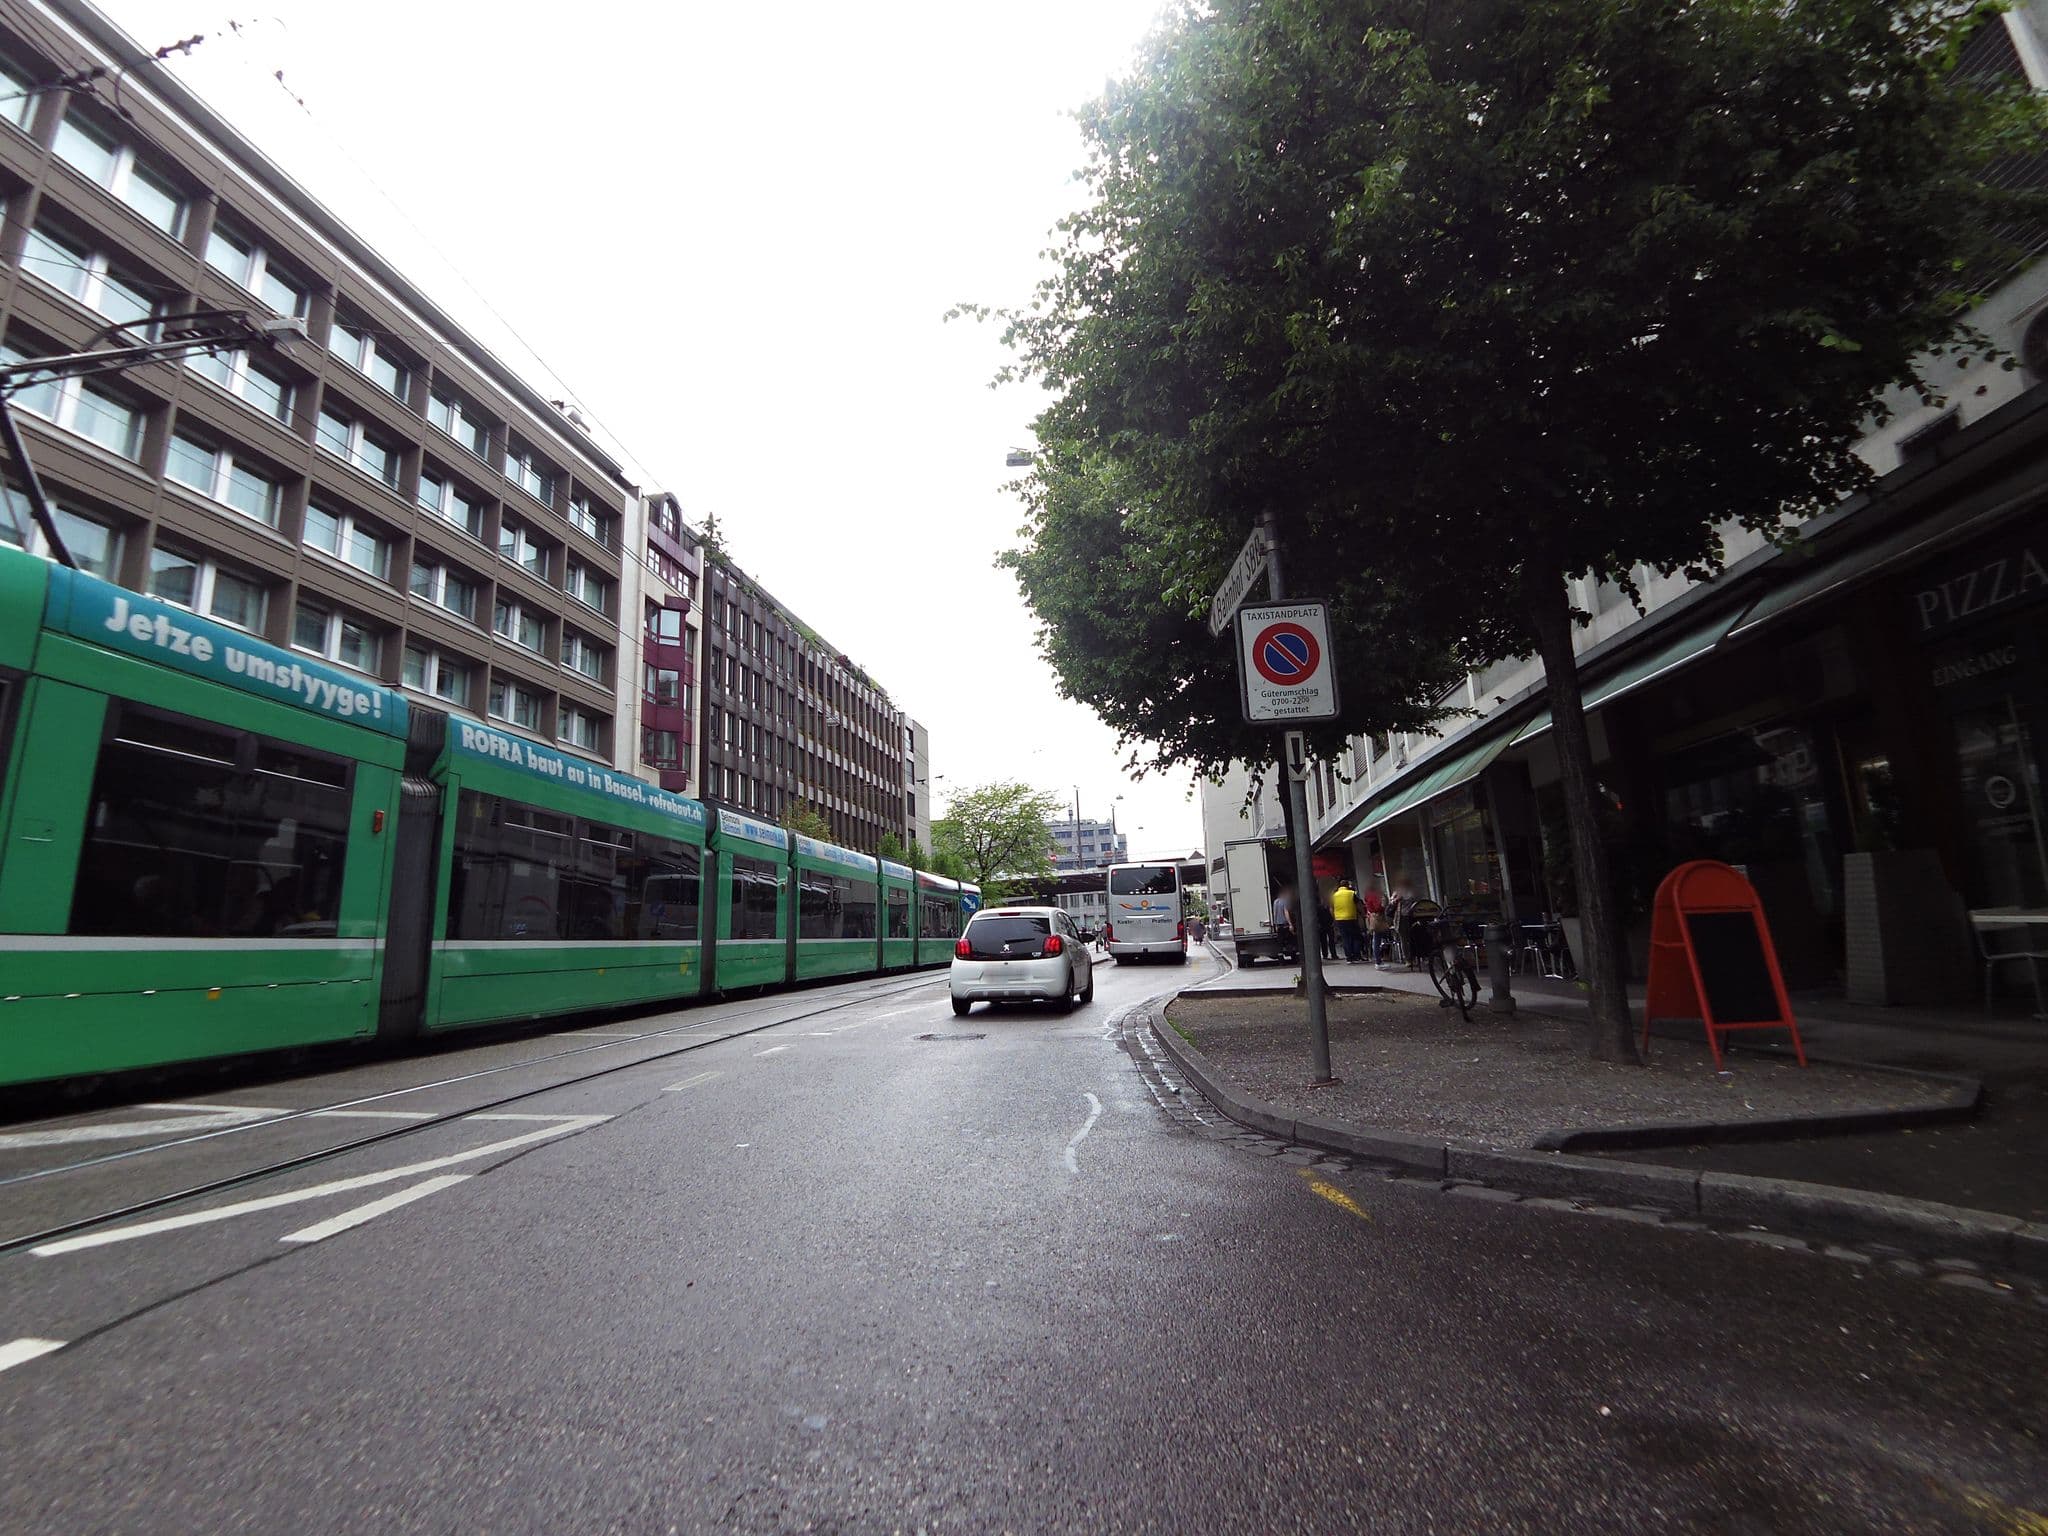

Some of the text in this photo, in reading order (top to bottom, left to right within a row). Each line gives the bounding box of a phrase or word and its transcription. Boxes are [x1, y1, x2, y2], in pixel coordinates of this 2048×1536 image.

[1216, 561, 1244, 625] Bahnhof
[1246, 607, 1319, 621] TAXISTANDPLATZ
[1914, 548, 2048, 632] PIZZA
[104, 596, 382, 719] Jetze umstyyge!
[1931, 645, 2017, 688] EINGANG
[1261, 687, 1319, 699] Güterumschlag
[1273, 705, 1310, 717] gestattet
[461, 724, 524, 766] ROFRA
[527, 746, 563, 778] baut
[567, 766, 585, 785] au
[588, 767, 602, 789] in
